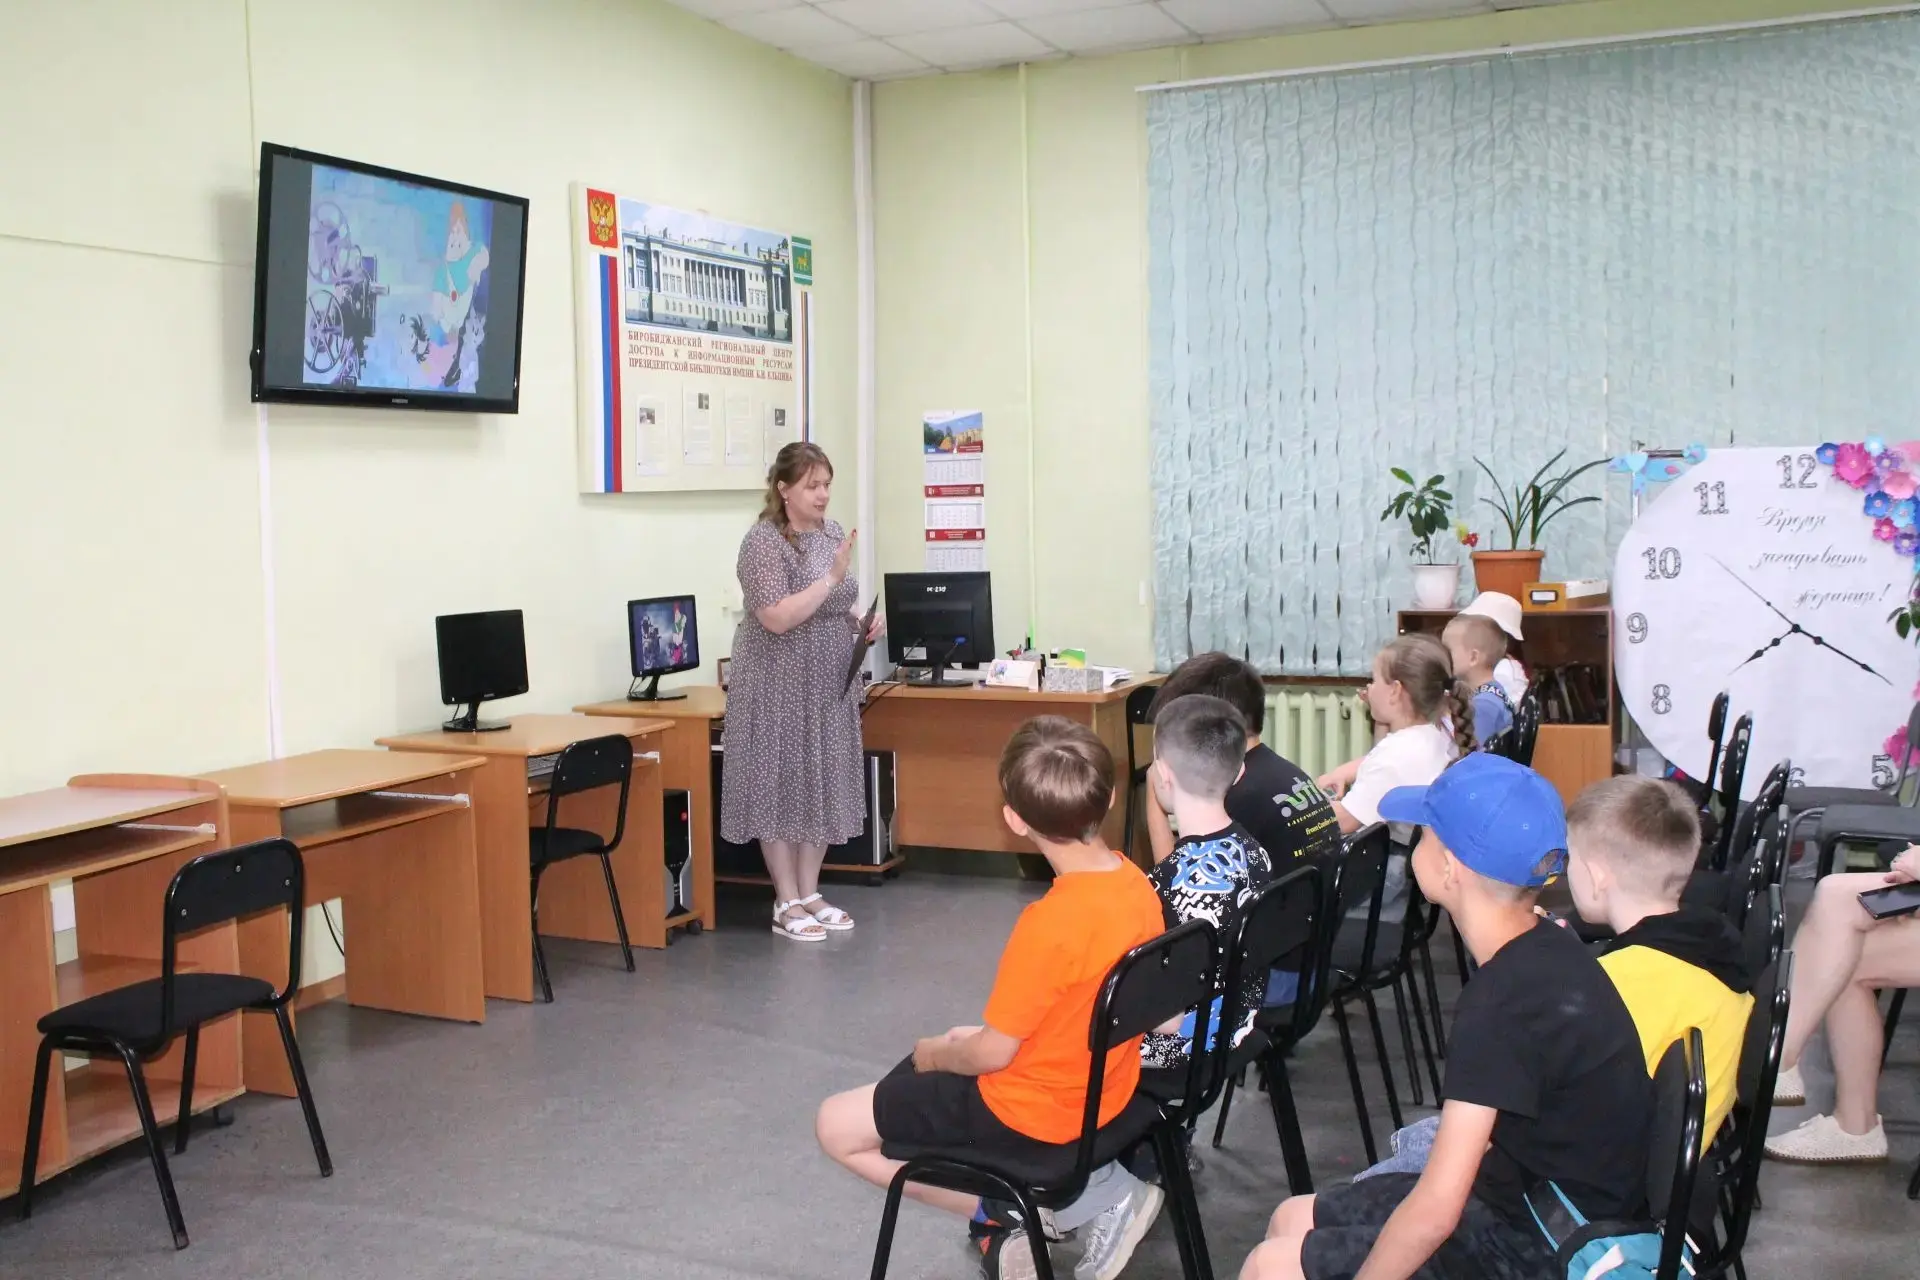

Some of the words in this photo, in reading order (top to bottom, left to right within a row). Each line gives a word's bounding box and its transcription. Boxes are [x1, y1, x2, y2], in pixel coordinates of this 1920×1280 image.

[628, 331, 702, 348] БИРОБИДЖАНСКИЙ
[711, 340, 765, 355] РЕГИОНАЛЬНЫЙ
[773, 347, 793, 358] ЦЕНТР
[628, 344, 665, 357] ДОСТУПА
[674, 349, 679, 358] К
[688, 350, 755, 366] ИНФОРМАЦИОННЫМ
[762, 359, 793, 370] РЕСУРСАМ
[629, 358, 689, 372] ПРЕЗИДЕНТСКОЙ
[690, 363, 731, 376] БИБЛИОТЕКИ
[733, 367, 754, 378] ИМЕНИ
[1776, 454, 1818, 489] 12
[1693, 481, 1730, 515] 11
[1641, 546, 1682, 580] 10
[1626, 612, 1648, 643] 9
[1651, 684, 1672, 714] 8
[1871, 754, 1894, 789] 5
